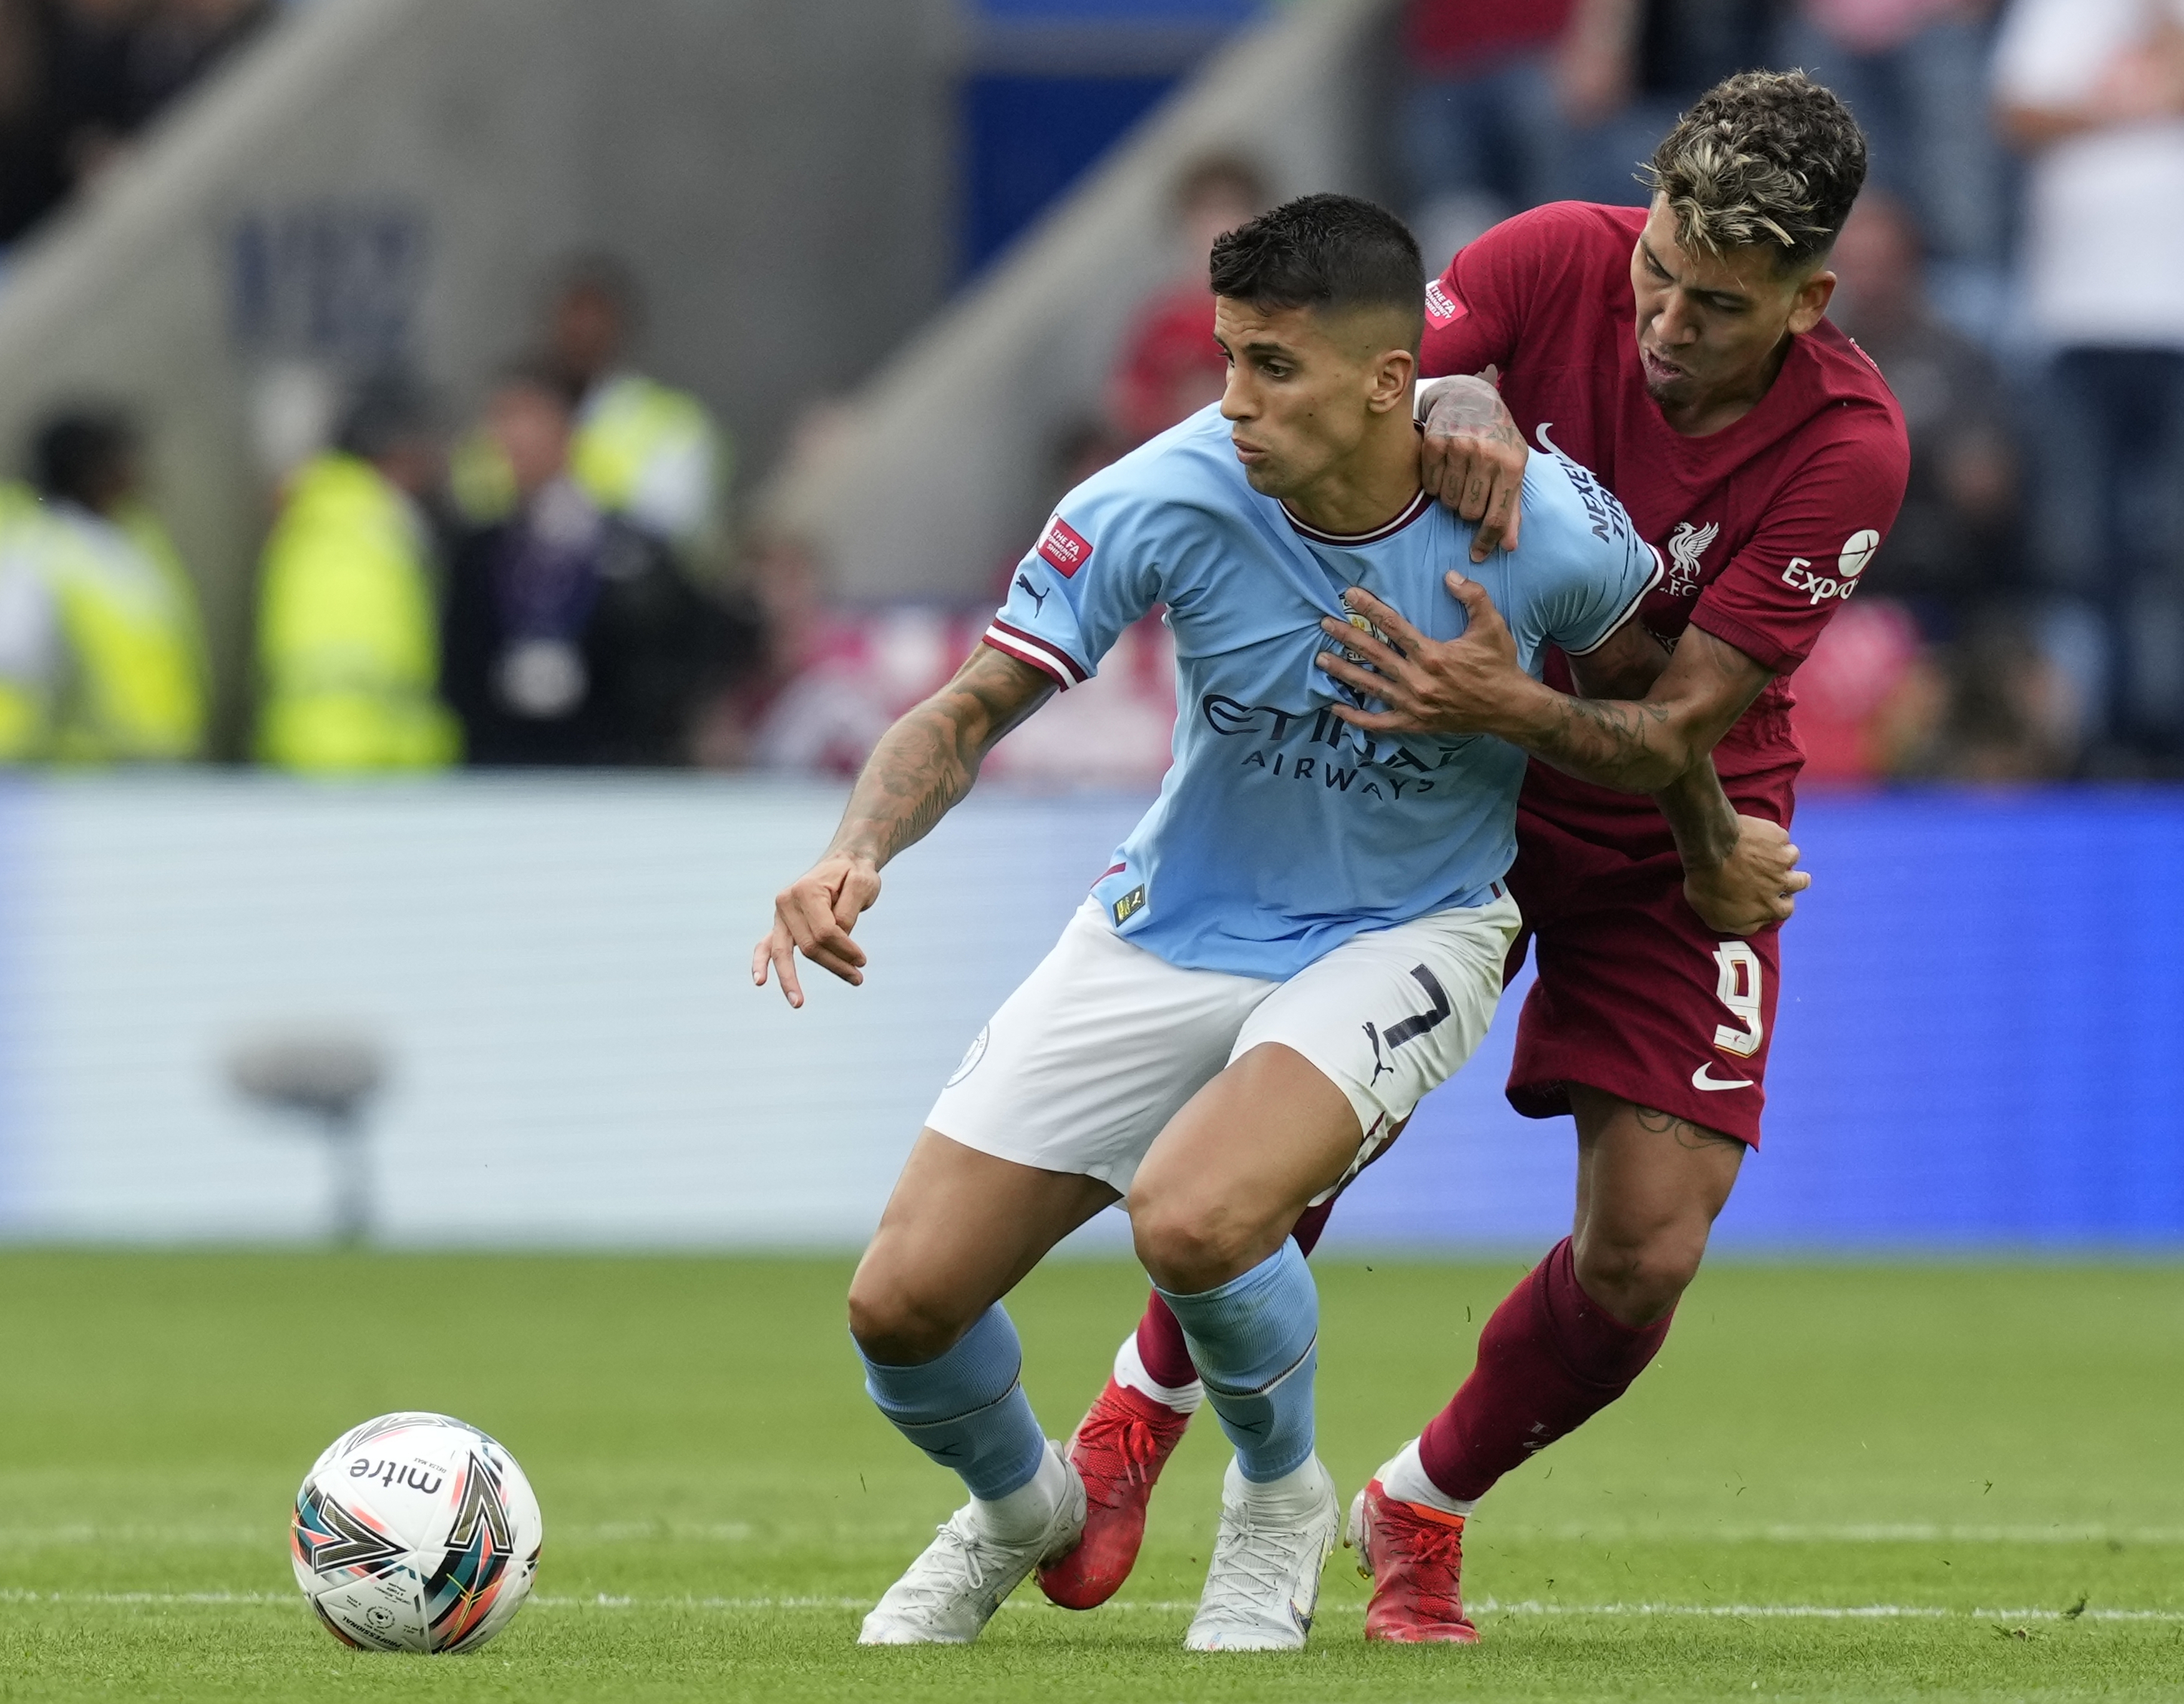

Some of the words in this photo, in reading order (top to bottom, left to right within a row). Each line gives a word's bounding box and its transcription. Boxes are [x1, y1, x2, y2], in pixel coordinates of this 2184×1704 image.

[1426, 289, 1452, 319] OMMUNITY
[1431, 285, 1446, 303] THE
[1441, 299, 1456, 314] FA
[1046, 543, 1067, 562] SHIELD
[1053, 529, 1068, 545] THE
[1065, 539, 1080, 556] FA
[1382, 963, 1451, 1049] 7
[1712, 941, 1763, 1058] 9
[350, 1458, 442, 1494] mitre
[343, 1615, 403, 1648] PROFESSIONAL
